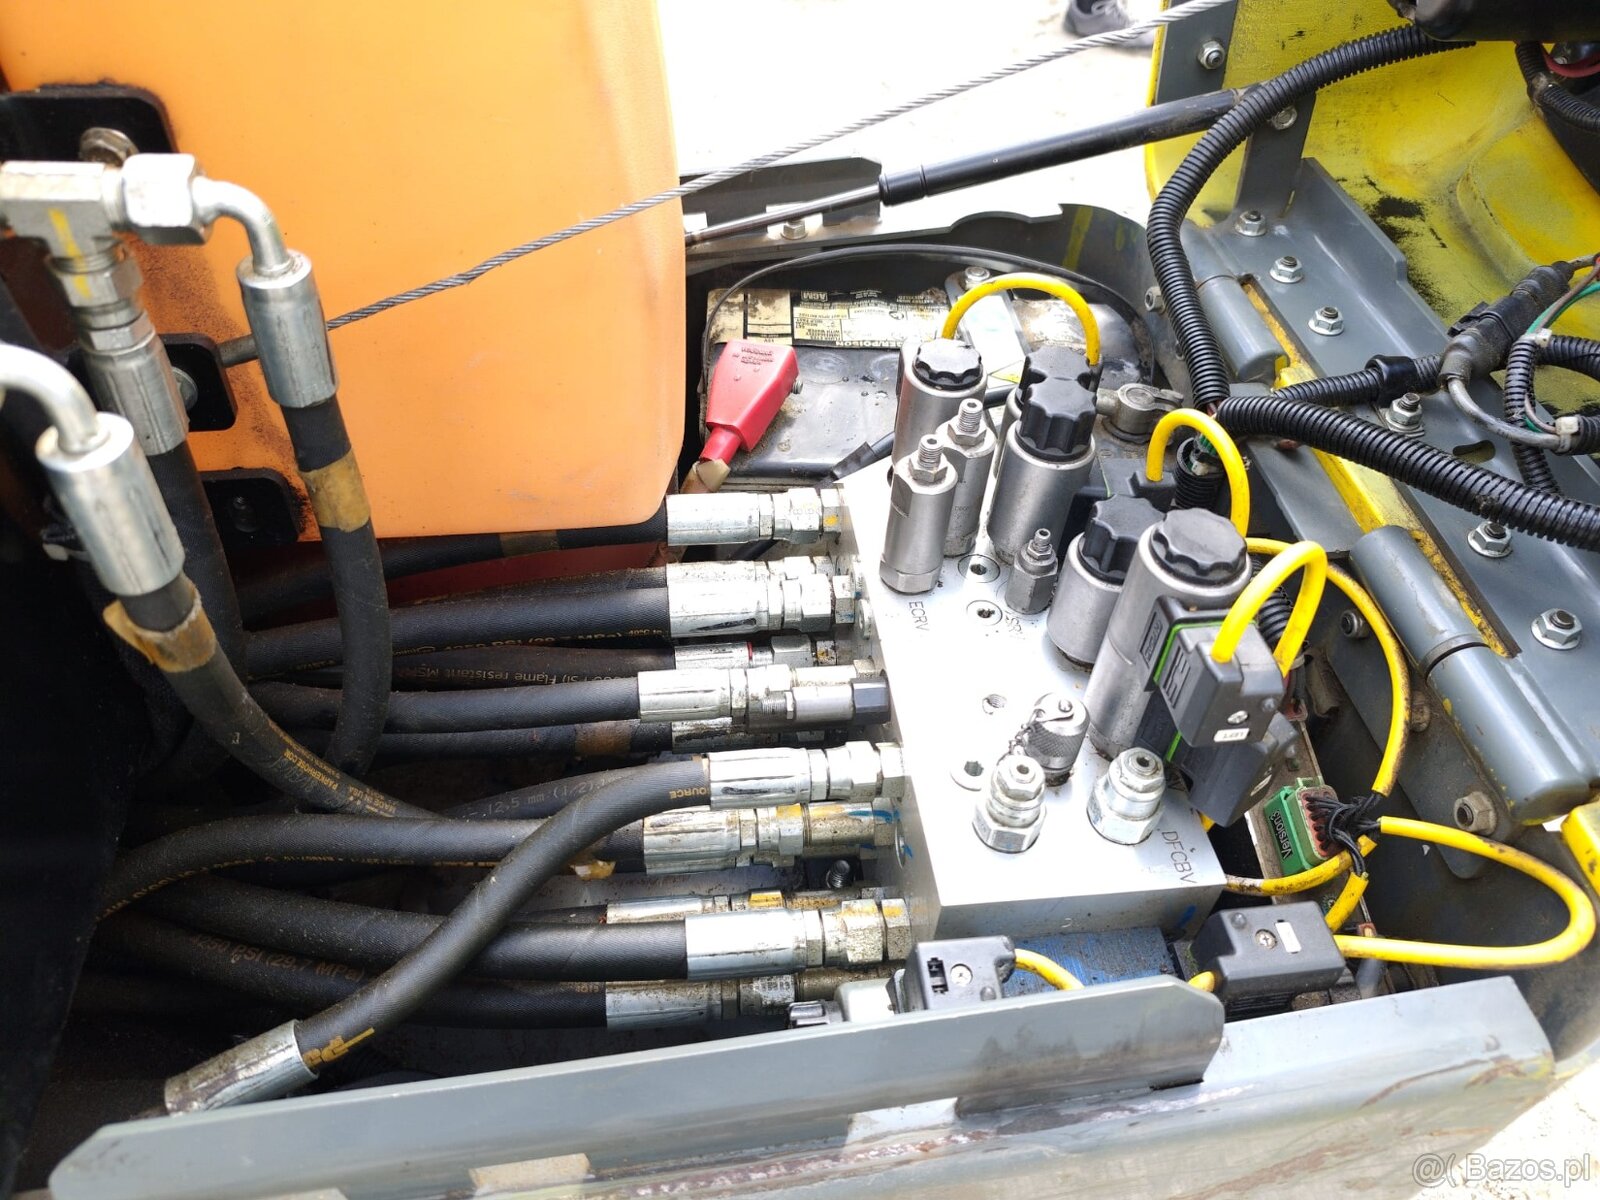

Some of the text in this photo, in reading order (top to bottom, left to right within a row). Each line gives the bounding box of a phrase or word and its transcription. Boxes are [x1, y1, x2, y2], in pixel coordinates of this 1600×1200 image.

[906, 601, 930, 632] ECRV
[445, 667, 509, 682] resistant
[515, 671, 557, 685] Flame
[669, 787, 709, 800] OURCE
[1269, 808, 1292, 860] Version3
[1160, 830, 1199, 884] DFCBV
